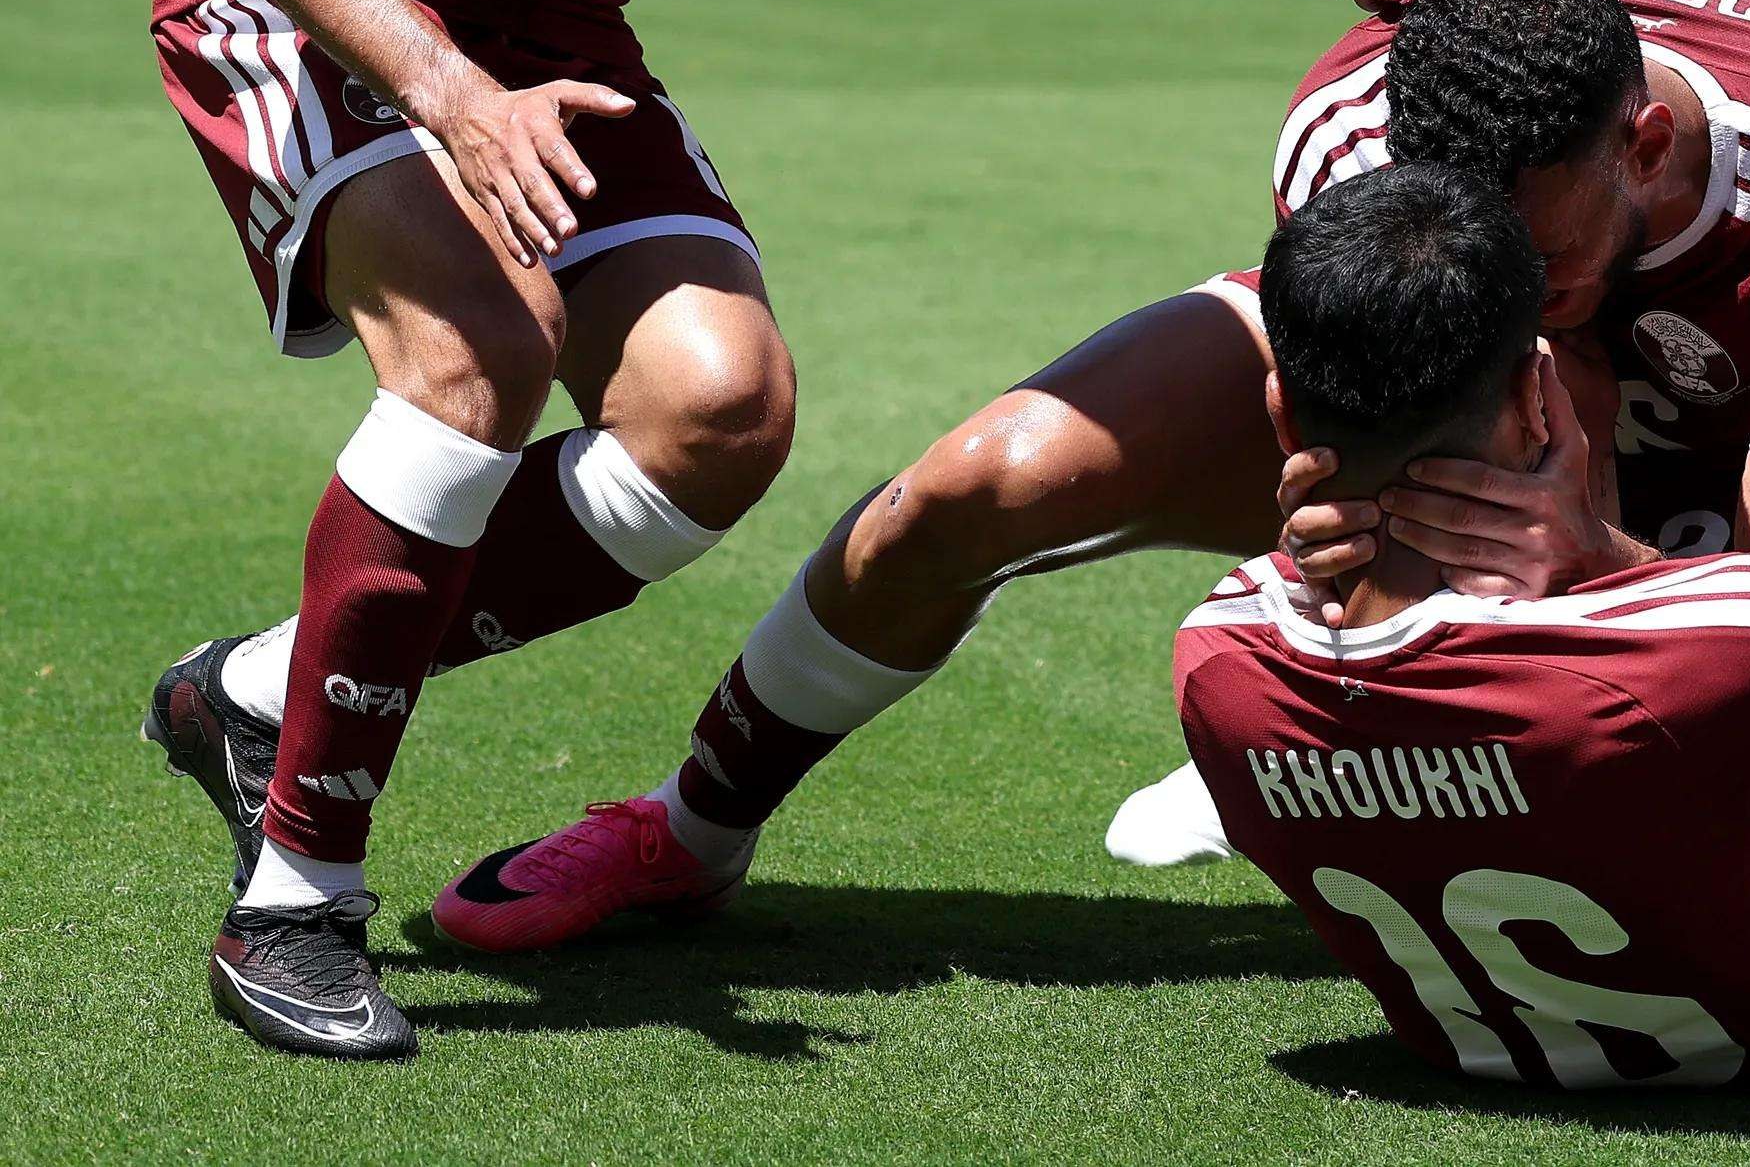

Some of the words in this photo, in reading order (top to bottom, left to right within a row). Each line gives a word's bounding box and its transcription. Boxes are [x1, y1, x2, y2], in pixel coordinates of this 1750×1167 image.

[1669, 371, 1718, 393] QFA
[324, 674, 407, 716] QFA
[1246, 742, 1530, 819] KHOUKHI
[1312, 867, 1746, 1090] 16
